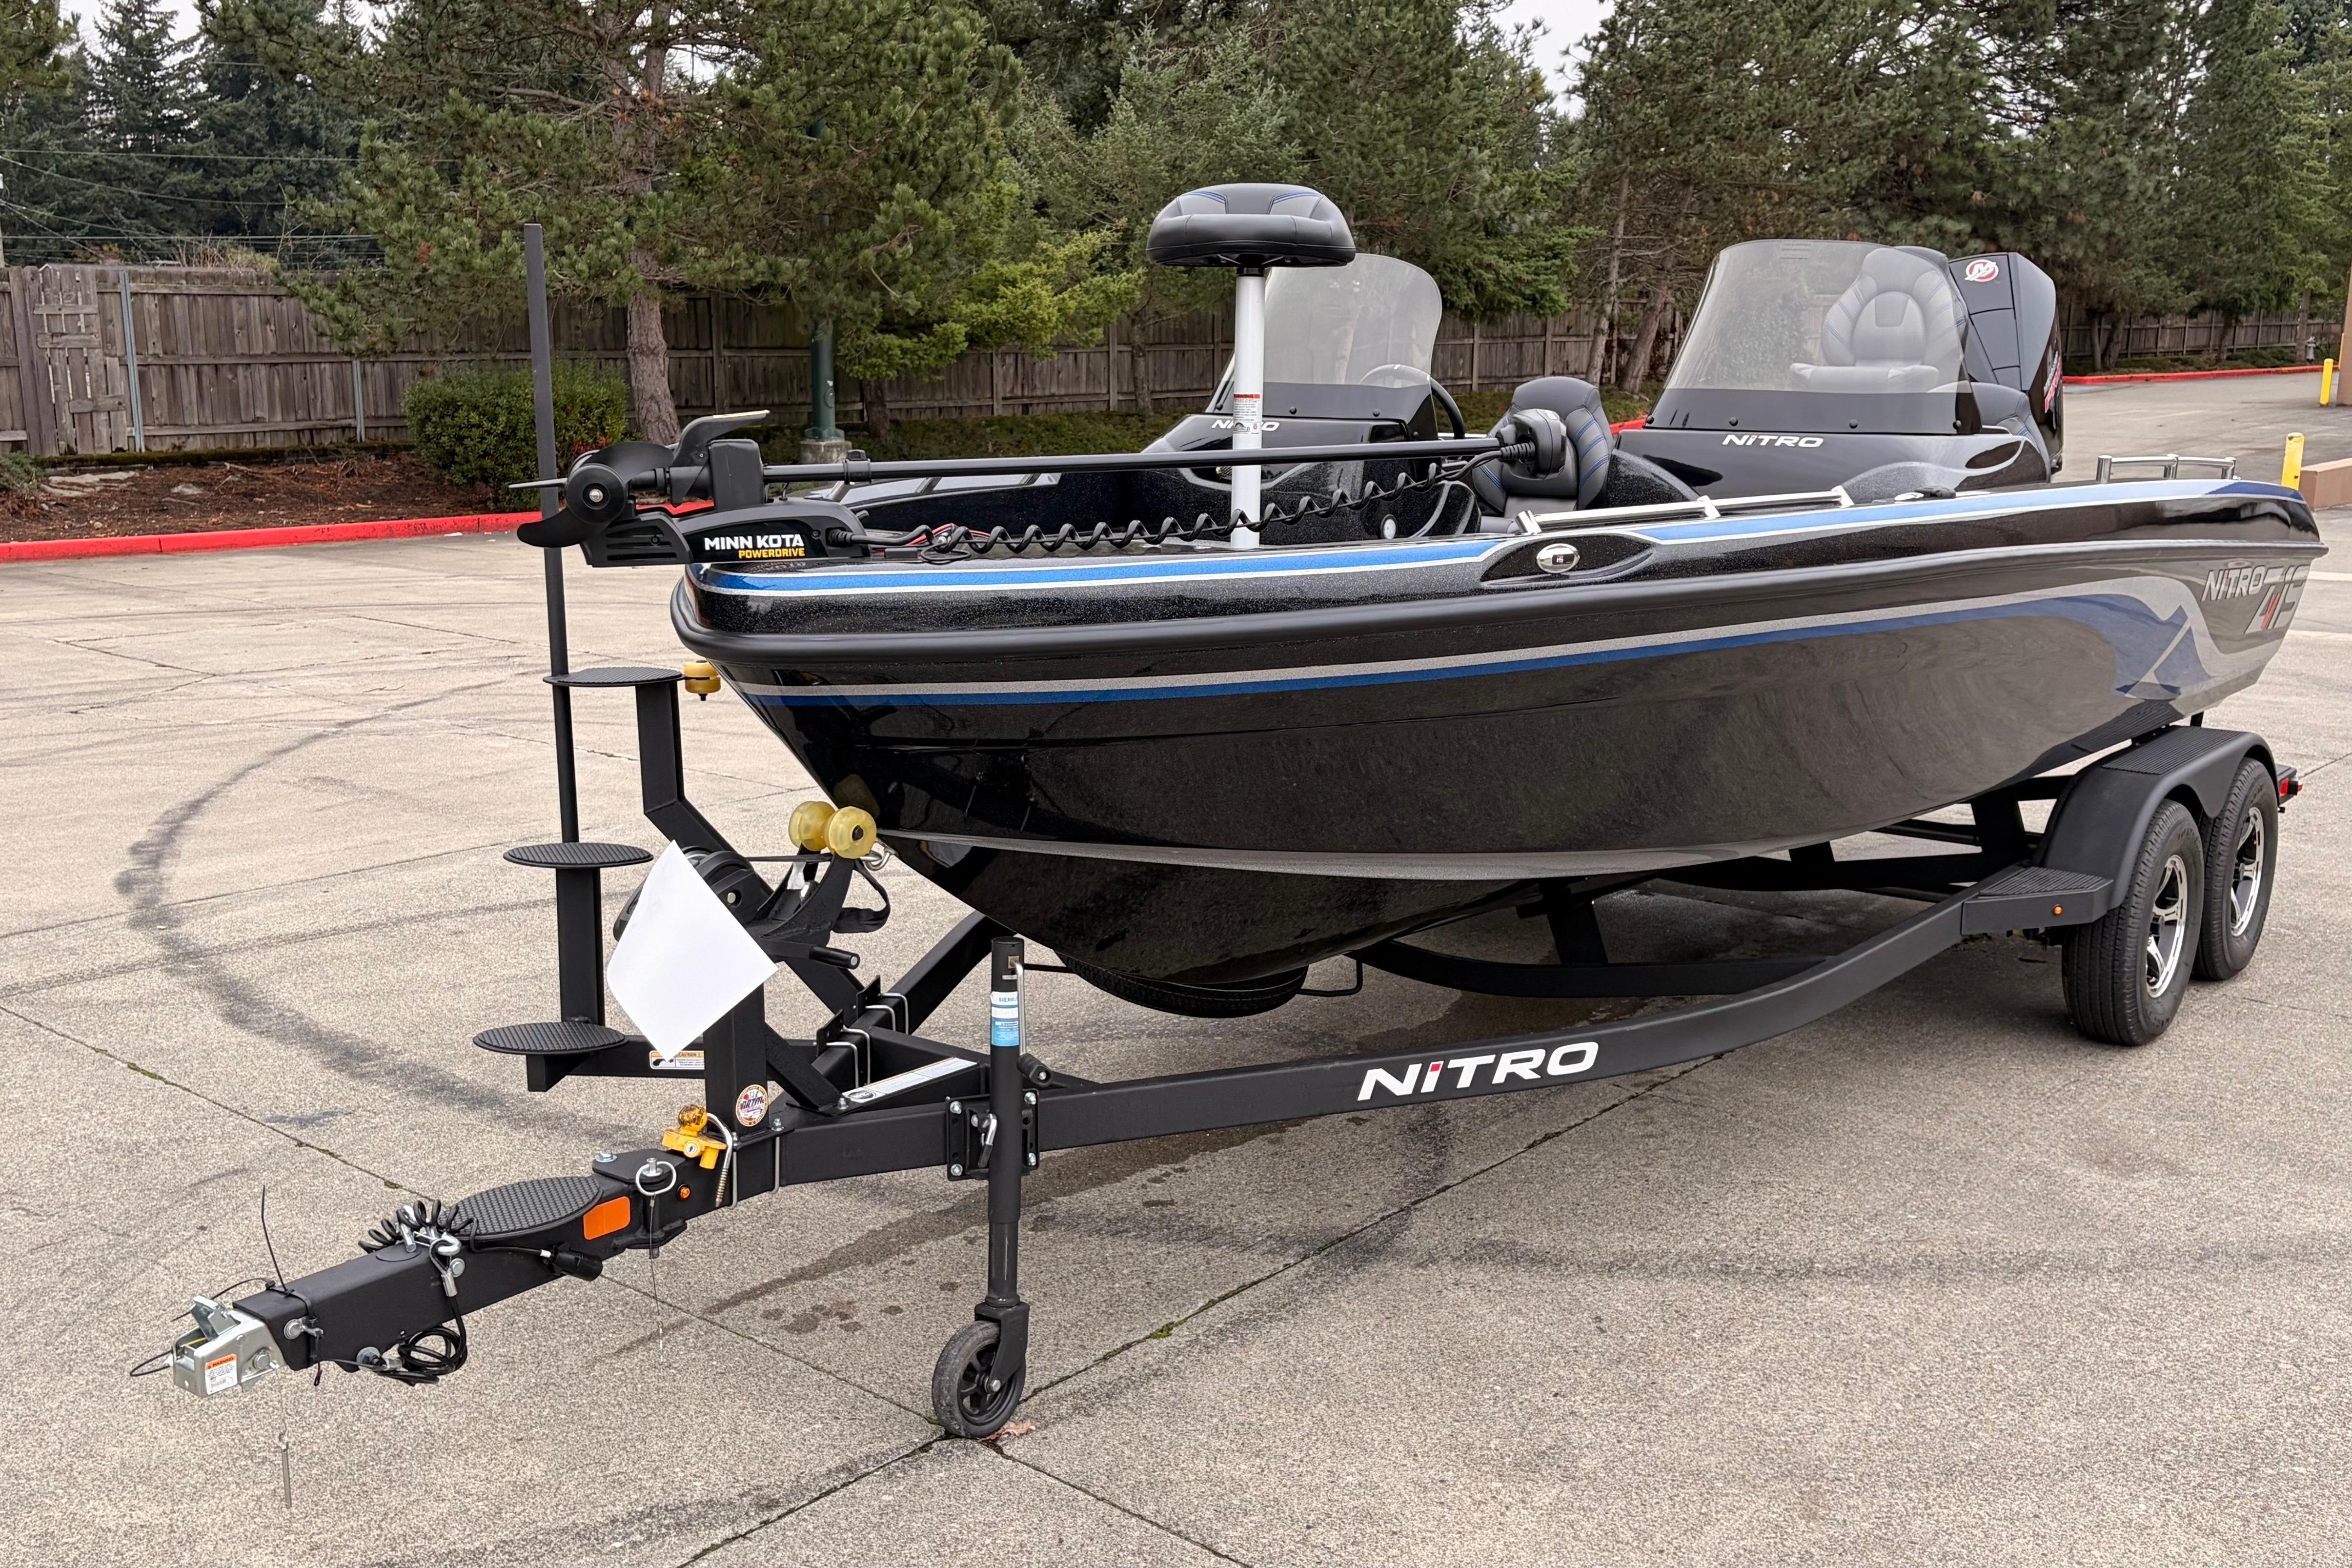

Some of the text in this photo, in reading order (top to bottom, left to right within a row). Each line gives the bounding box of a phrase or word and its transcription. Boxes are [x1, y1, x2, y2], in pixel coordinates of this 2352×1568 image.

[1212, 420, 1280, 431] NIO
[1722, 434, 1824, 448] NITRO
[704, 534, 805, 550] MINN KOTA
[738, 548, 805, 559] POWERDRIVE
[2200, 565, 2266, 602] NITRO
[1357, 1041, 1599, 1101] NITRO
